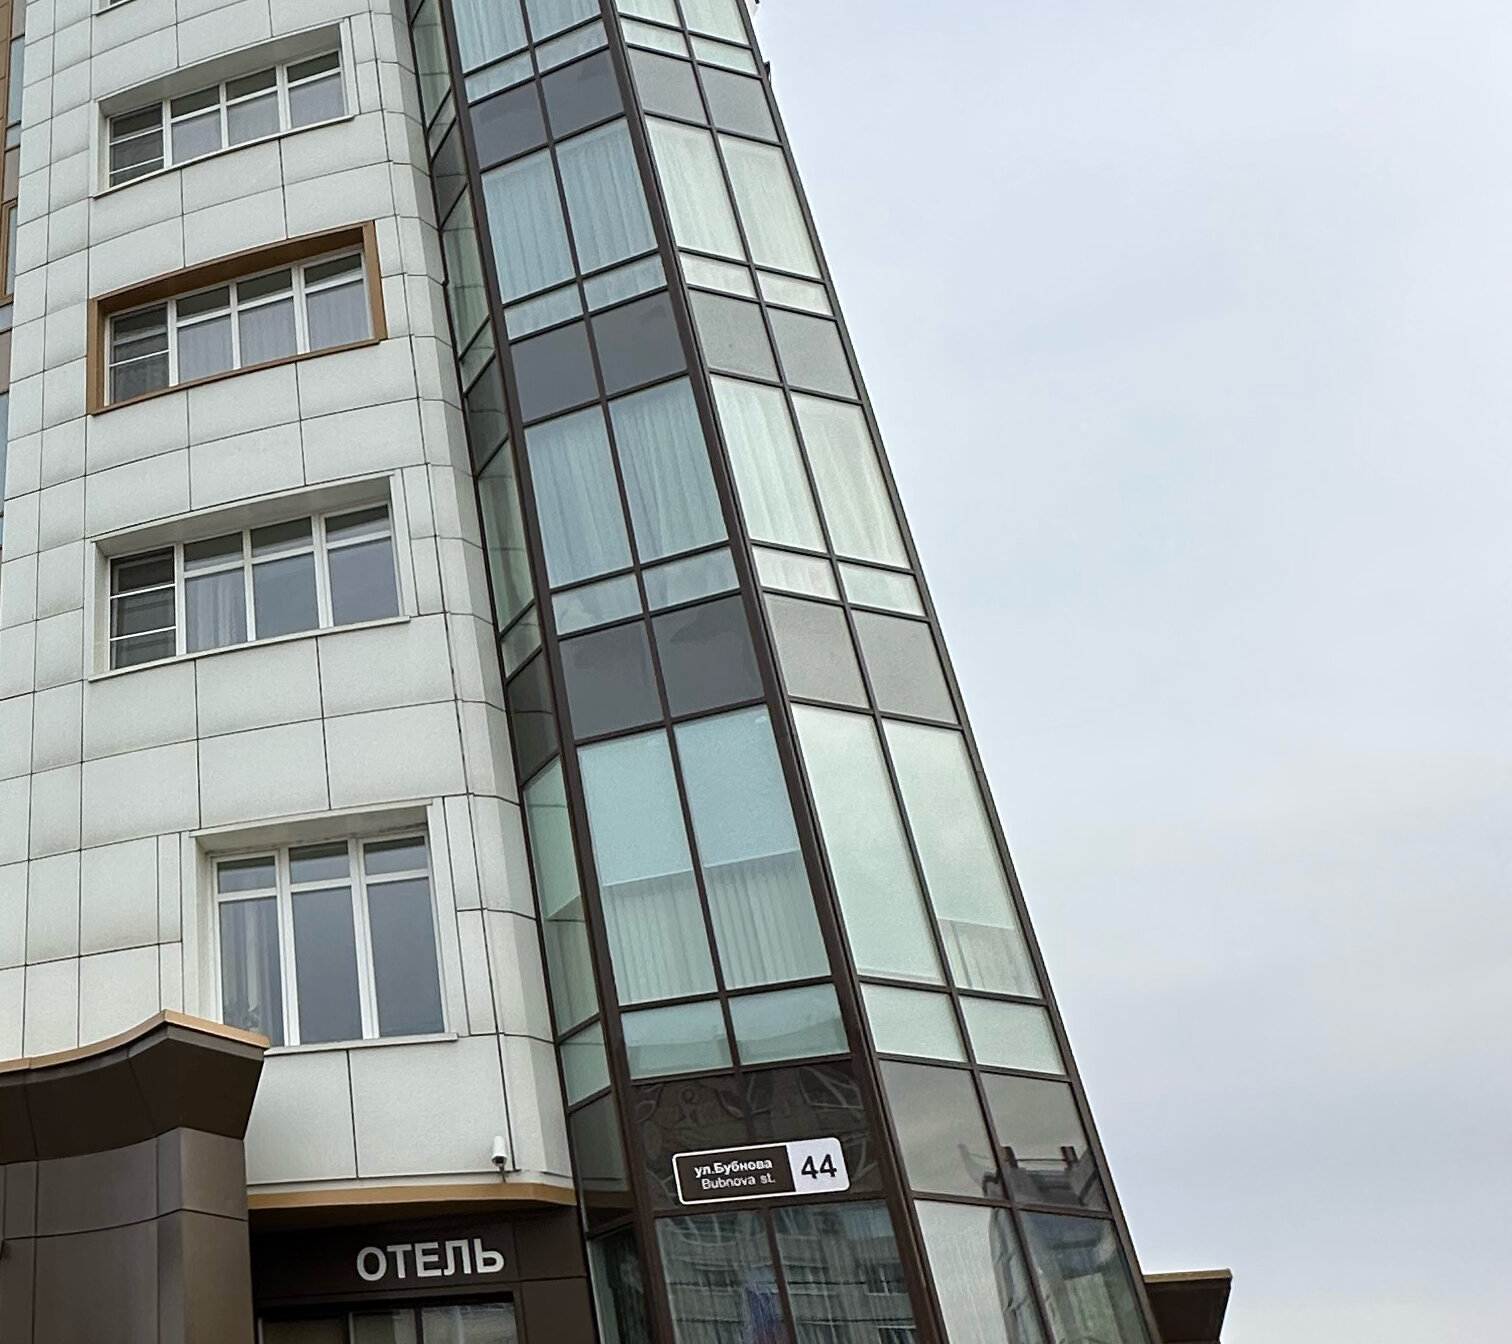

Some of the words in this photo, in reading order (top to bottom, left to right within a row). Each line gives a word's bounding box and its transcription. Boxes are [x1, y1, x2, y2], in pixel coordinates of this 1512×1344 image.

[694, 1158, 773, 1178] ул.Бубнова
[801, 1154, 838, 1179] 44
[701, 1176, 756, 1190] Bubnova
[760, 1172, 776, 1185] st.
[356, 1238, 505, 1281] ОТЕЛЬ
